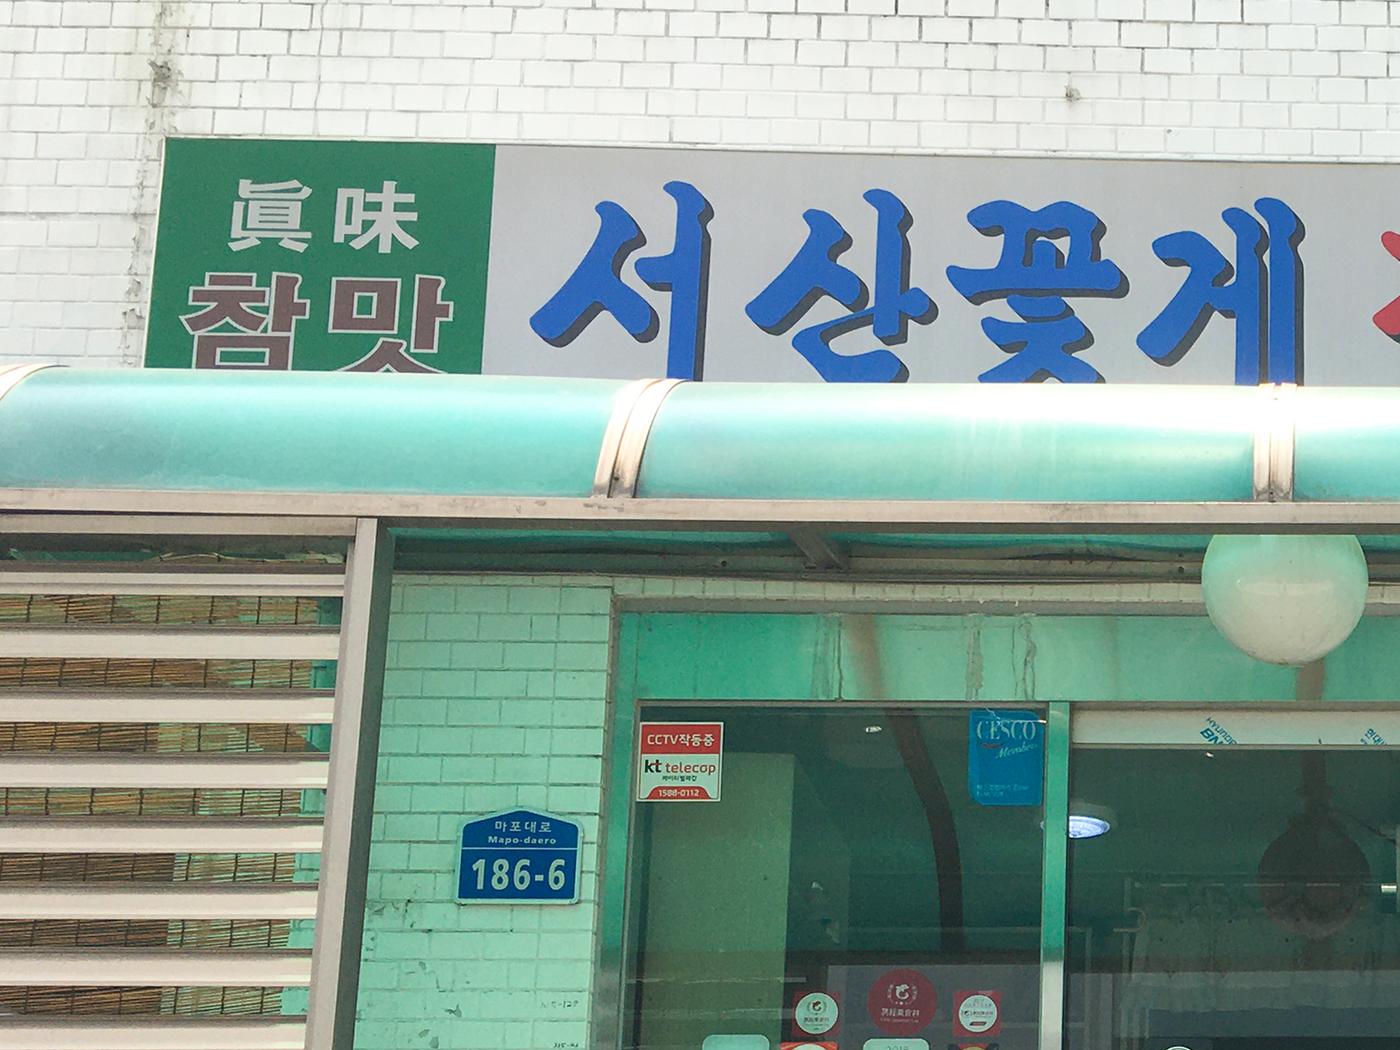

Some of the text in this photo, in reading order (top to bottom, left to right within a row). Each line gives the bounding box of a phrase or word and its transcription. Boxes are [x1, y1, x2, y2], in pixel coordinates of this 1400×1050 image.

[976, 719, 1037, 740] CESCO
[644, 759, 716, 776] kt telecop
[658, 789, 700, 797] 1588-0112
[494, 821, 552, 833] 마포대로
[487, 836, 557, 845] Mapo-daero
[471, 858, 566, 891] 186-6
